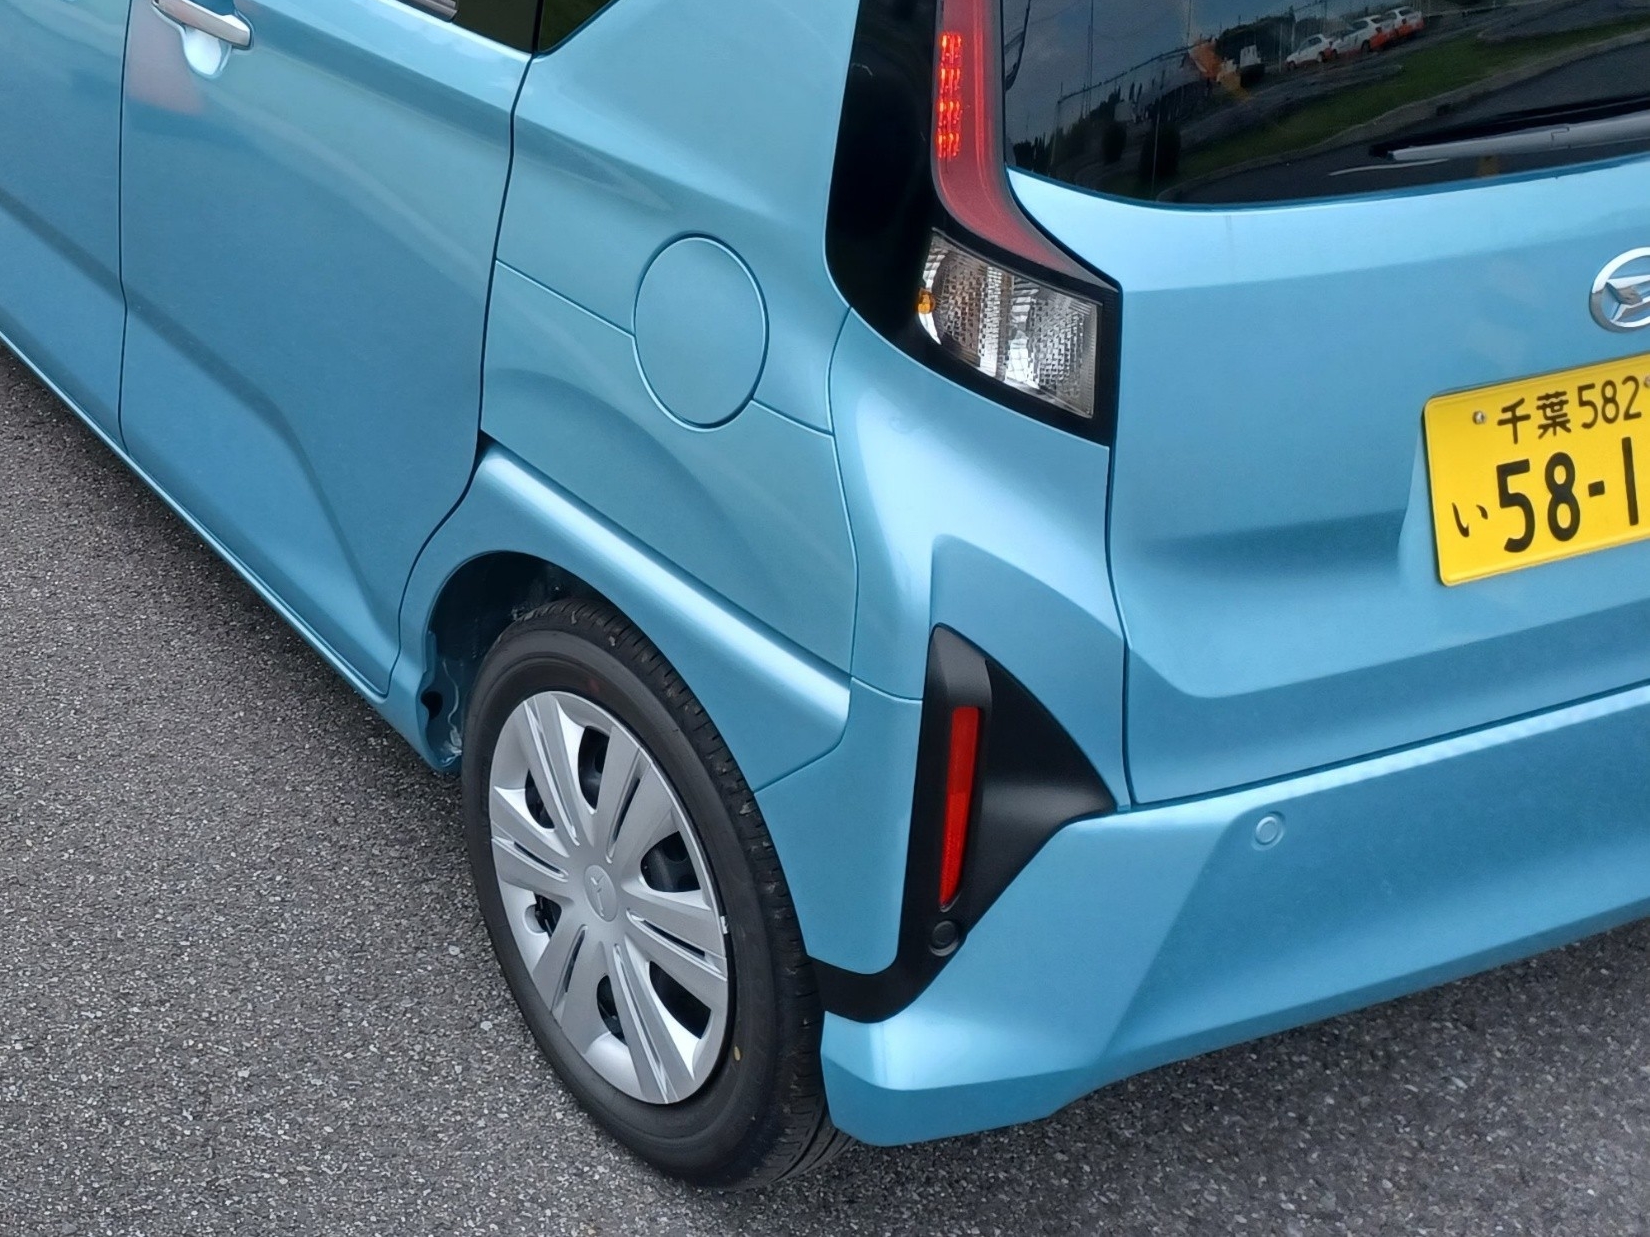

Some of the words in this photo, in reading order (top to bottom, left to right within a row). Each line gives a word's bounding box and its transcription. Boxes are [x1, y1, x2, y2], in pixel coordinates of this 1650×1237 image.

[1497, 390, 1572, 445] 千葉
[1577, 375, 1643, 430] 582
[1451, 502, 1489, 538] い
[1495, 436, 1640, 554] 58-1
